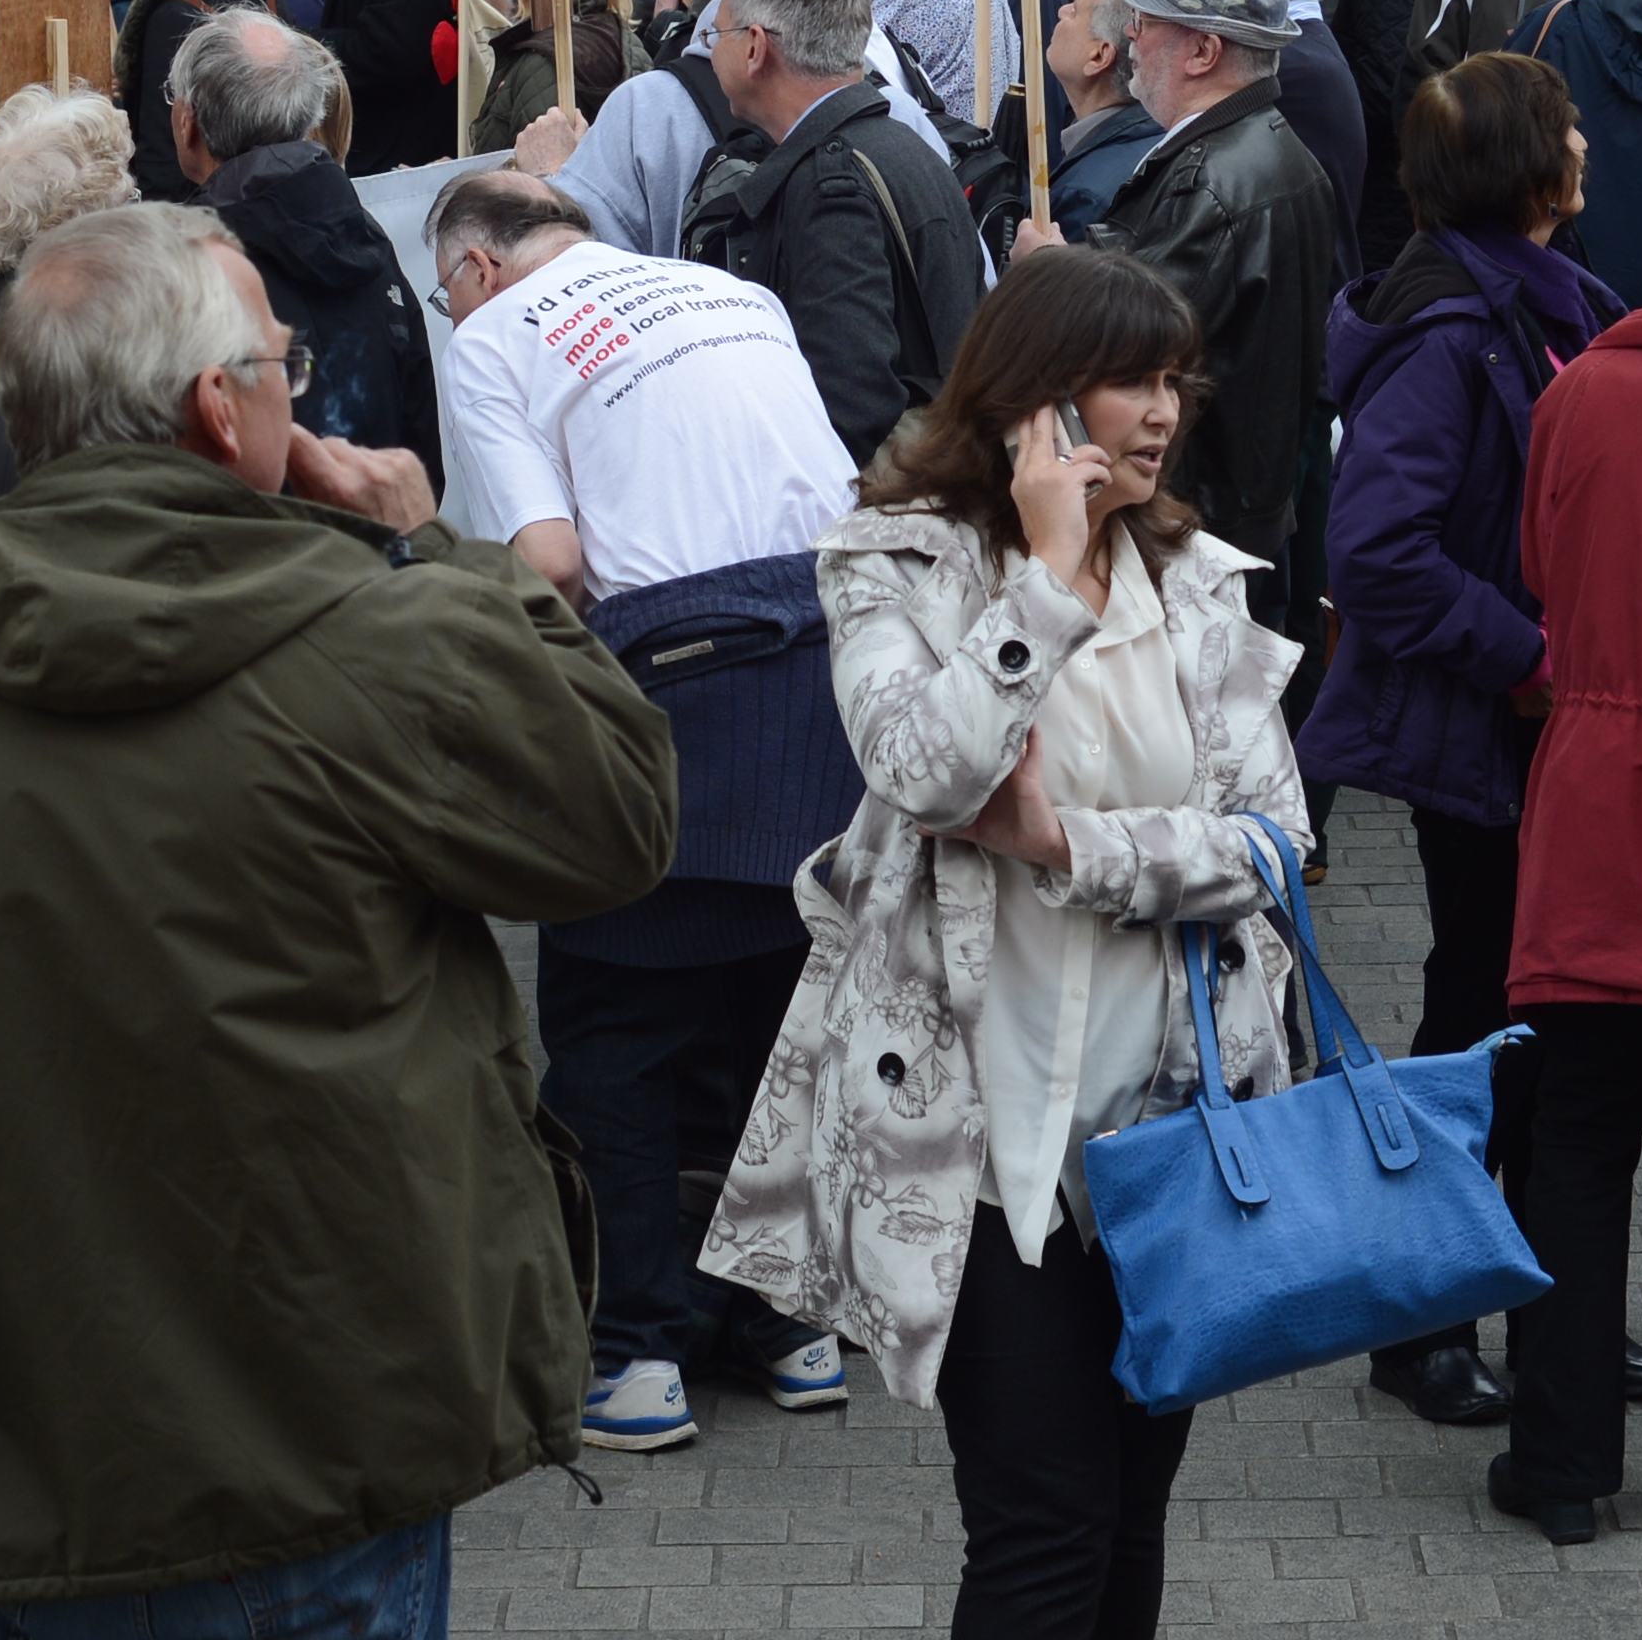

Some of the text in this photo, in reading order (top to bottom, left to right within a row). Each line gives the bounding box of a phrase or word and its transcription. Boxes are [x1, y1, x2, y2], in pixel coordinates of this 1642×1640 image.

[544, 273, 670, 347] more nurses
[560, 263, 648, 300] rather
[564, 281, 705, 367] more teachers
[578, 331, 631, 382] more
[629, 300, 685, 335] local
[808, 1346, 825, 1359] NIKE
